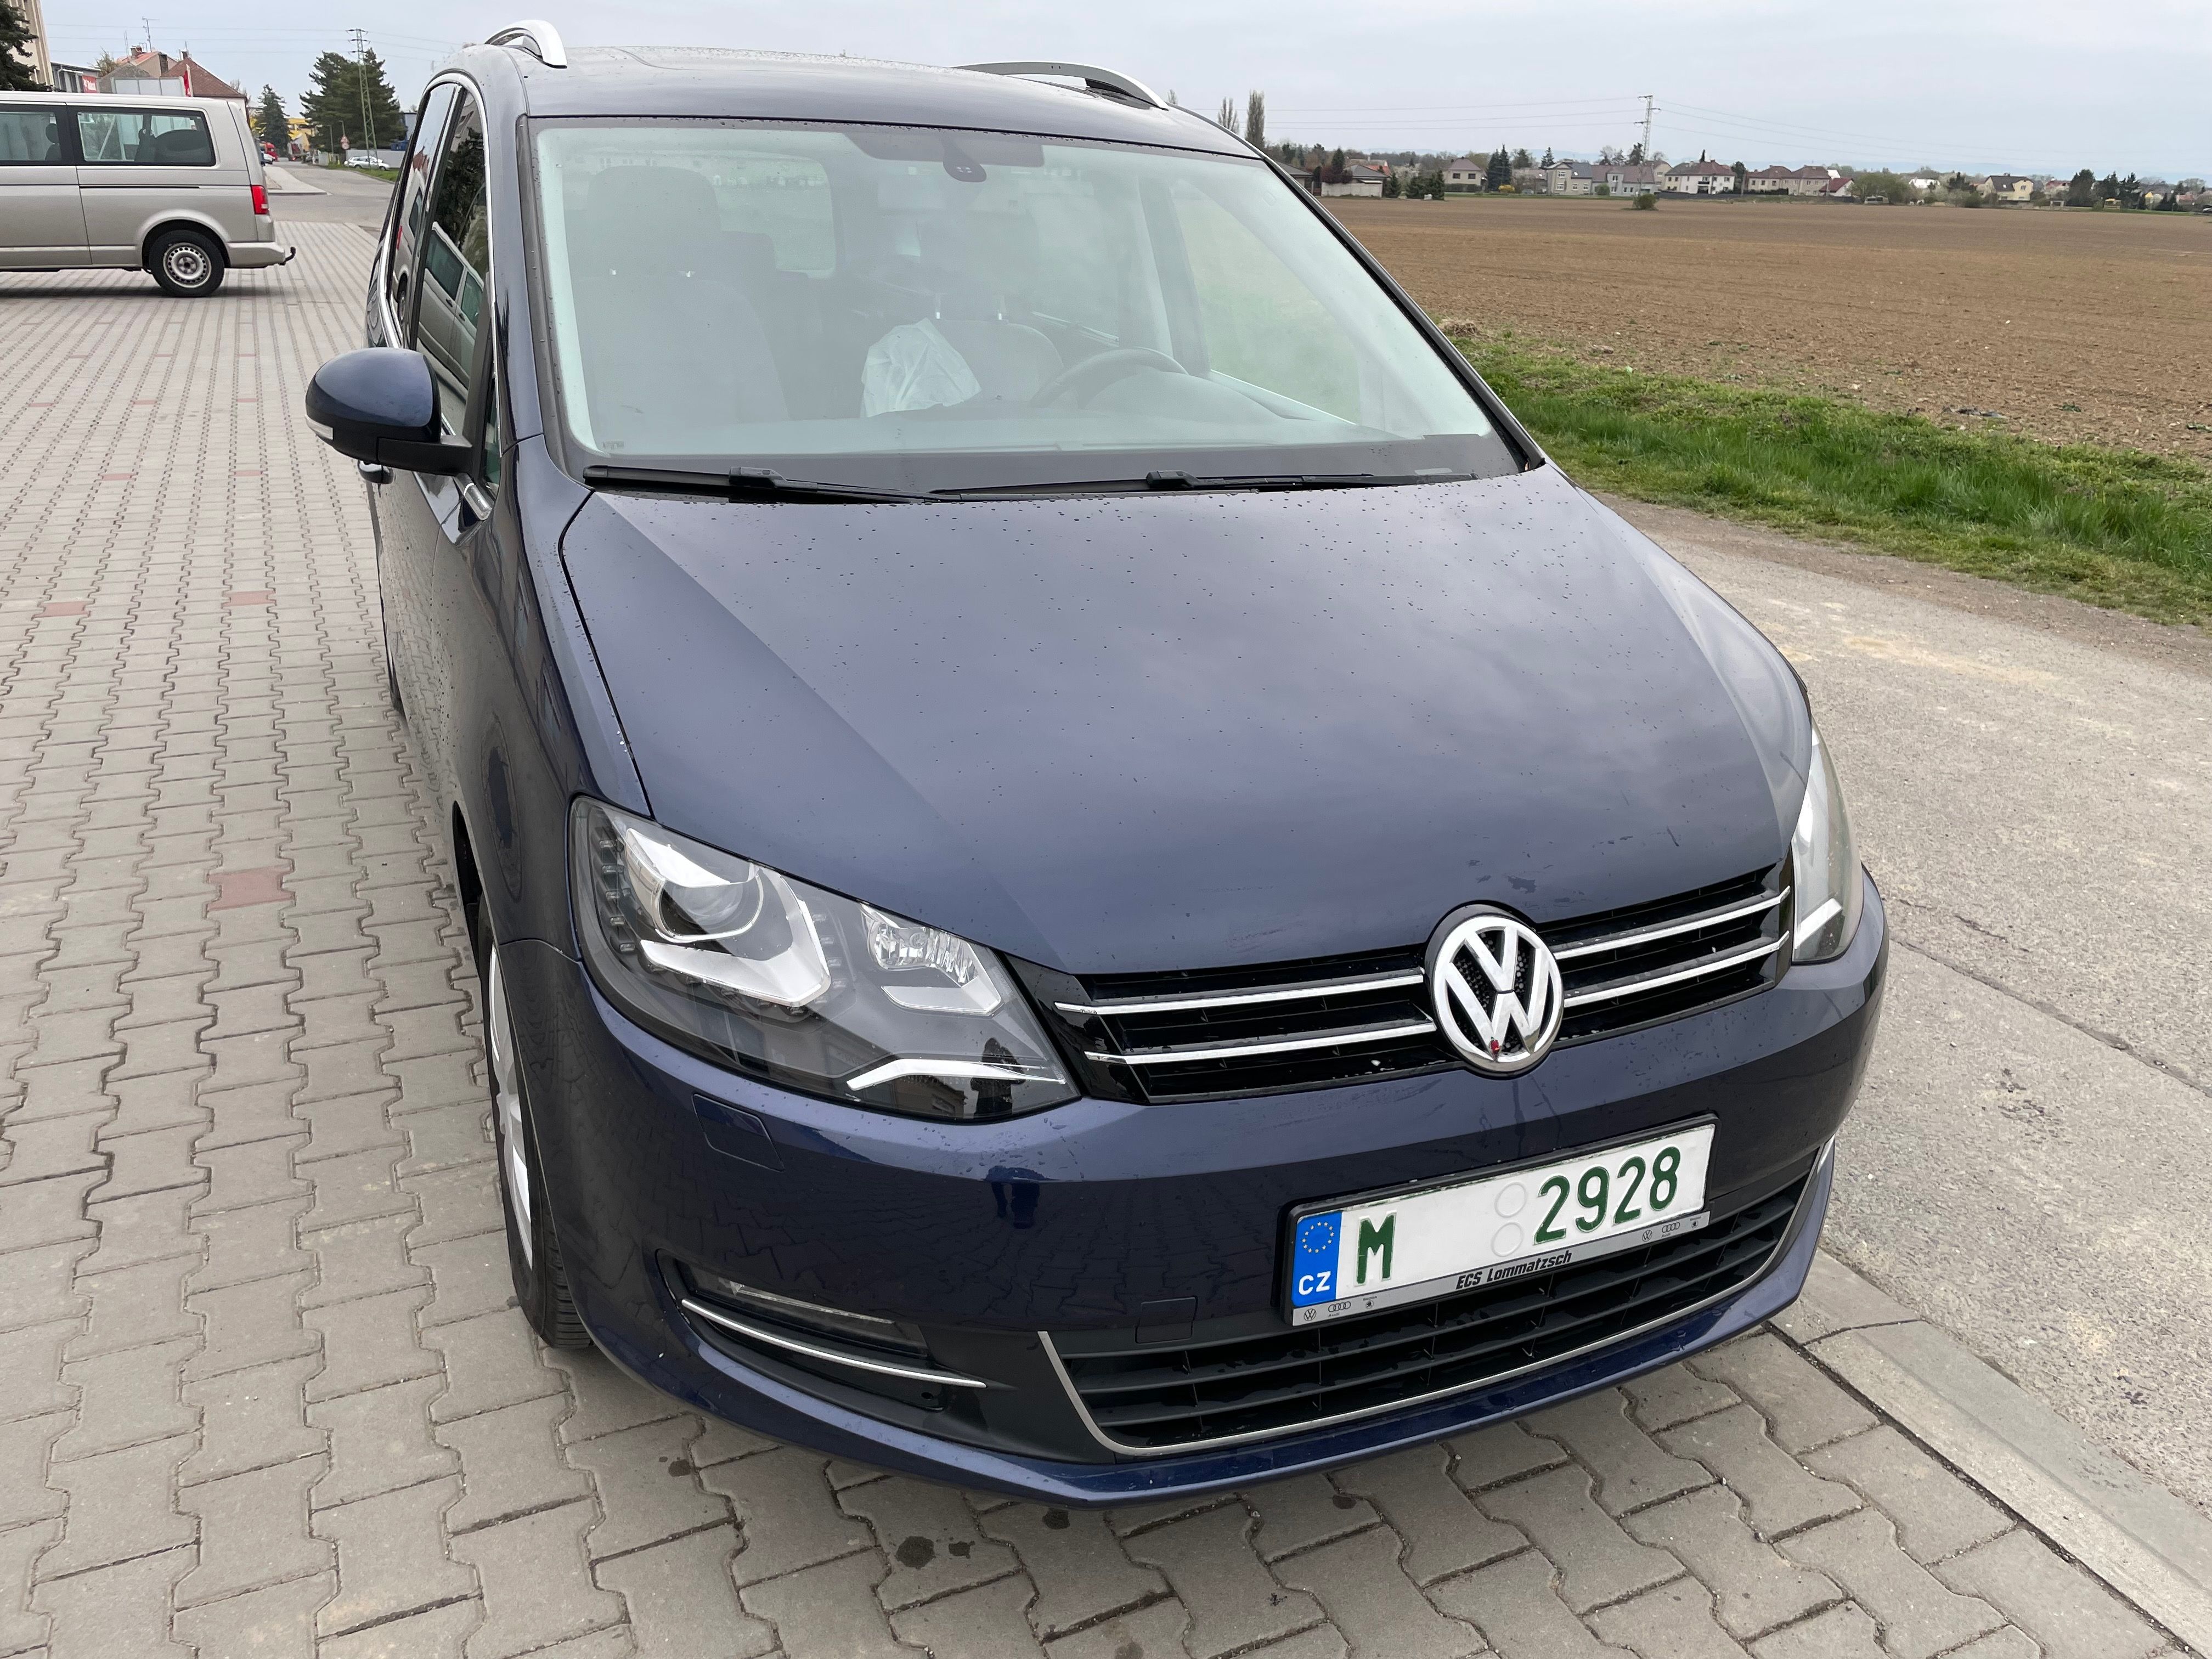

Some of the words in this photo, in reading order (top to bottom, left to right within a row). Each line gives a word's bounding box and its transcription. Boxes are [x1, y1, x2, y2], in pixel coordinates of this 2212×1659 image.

[1433, 916, 1562, 1073] VW
[1355, 1212, 1396, 1286] M
[1533, 1146, 1681, 1245] 2928
[1299, 1271, 1331, 1296] CZ
[1455, 1271, 1482, 1290] ECS
[1486, 1250, 1572, 1283] Lommatzsch
